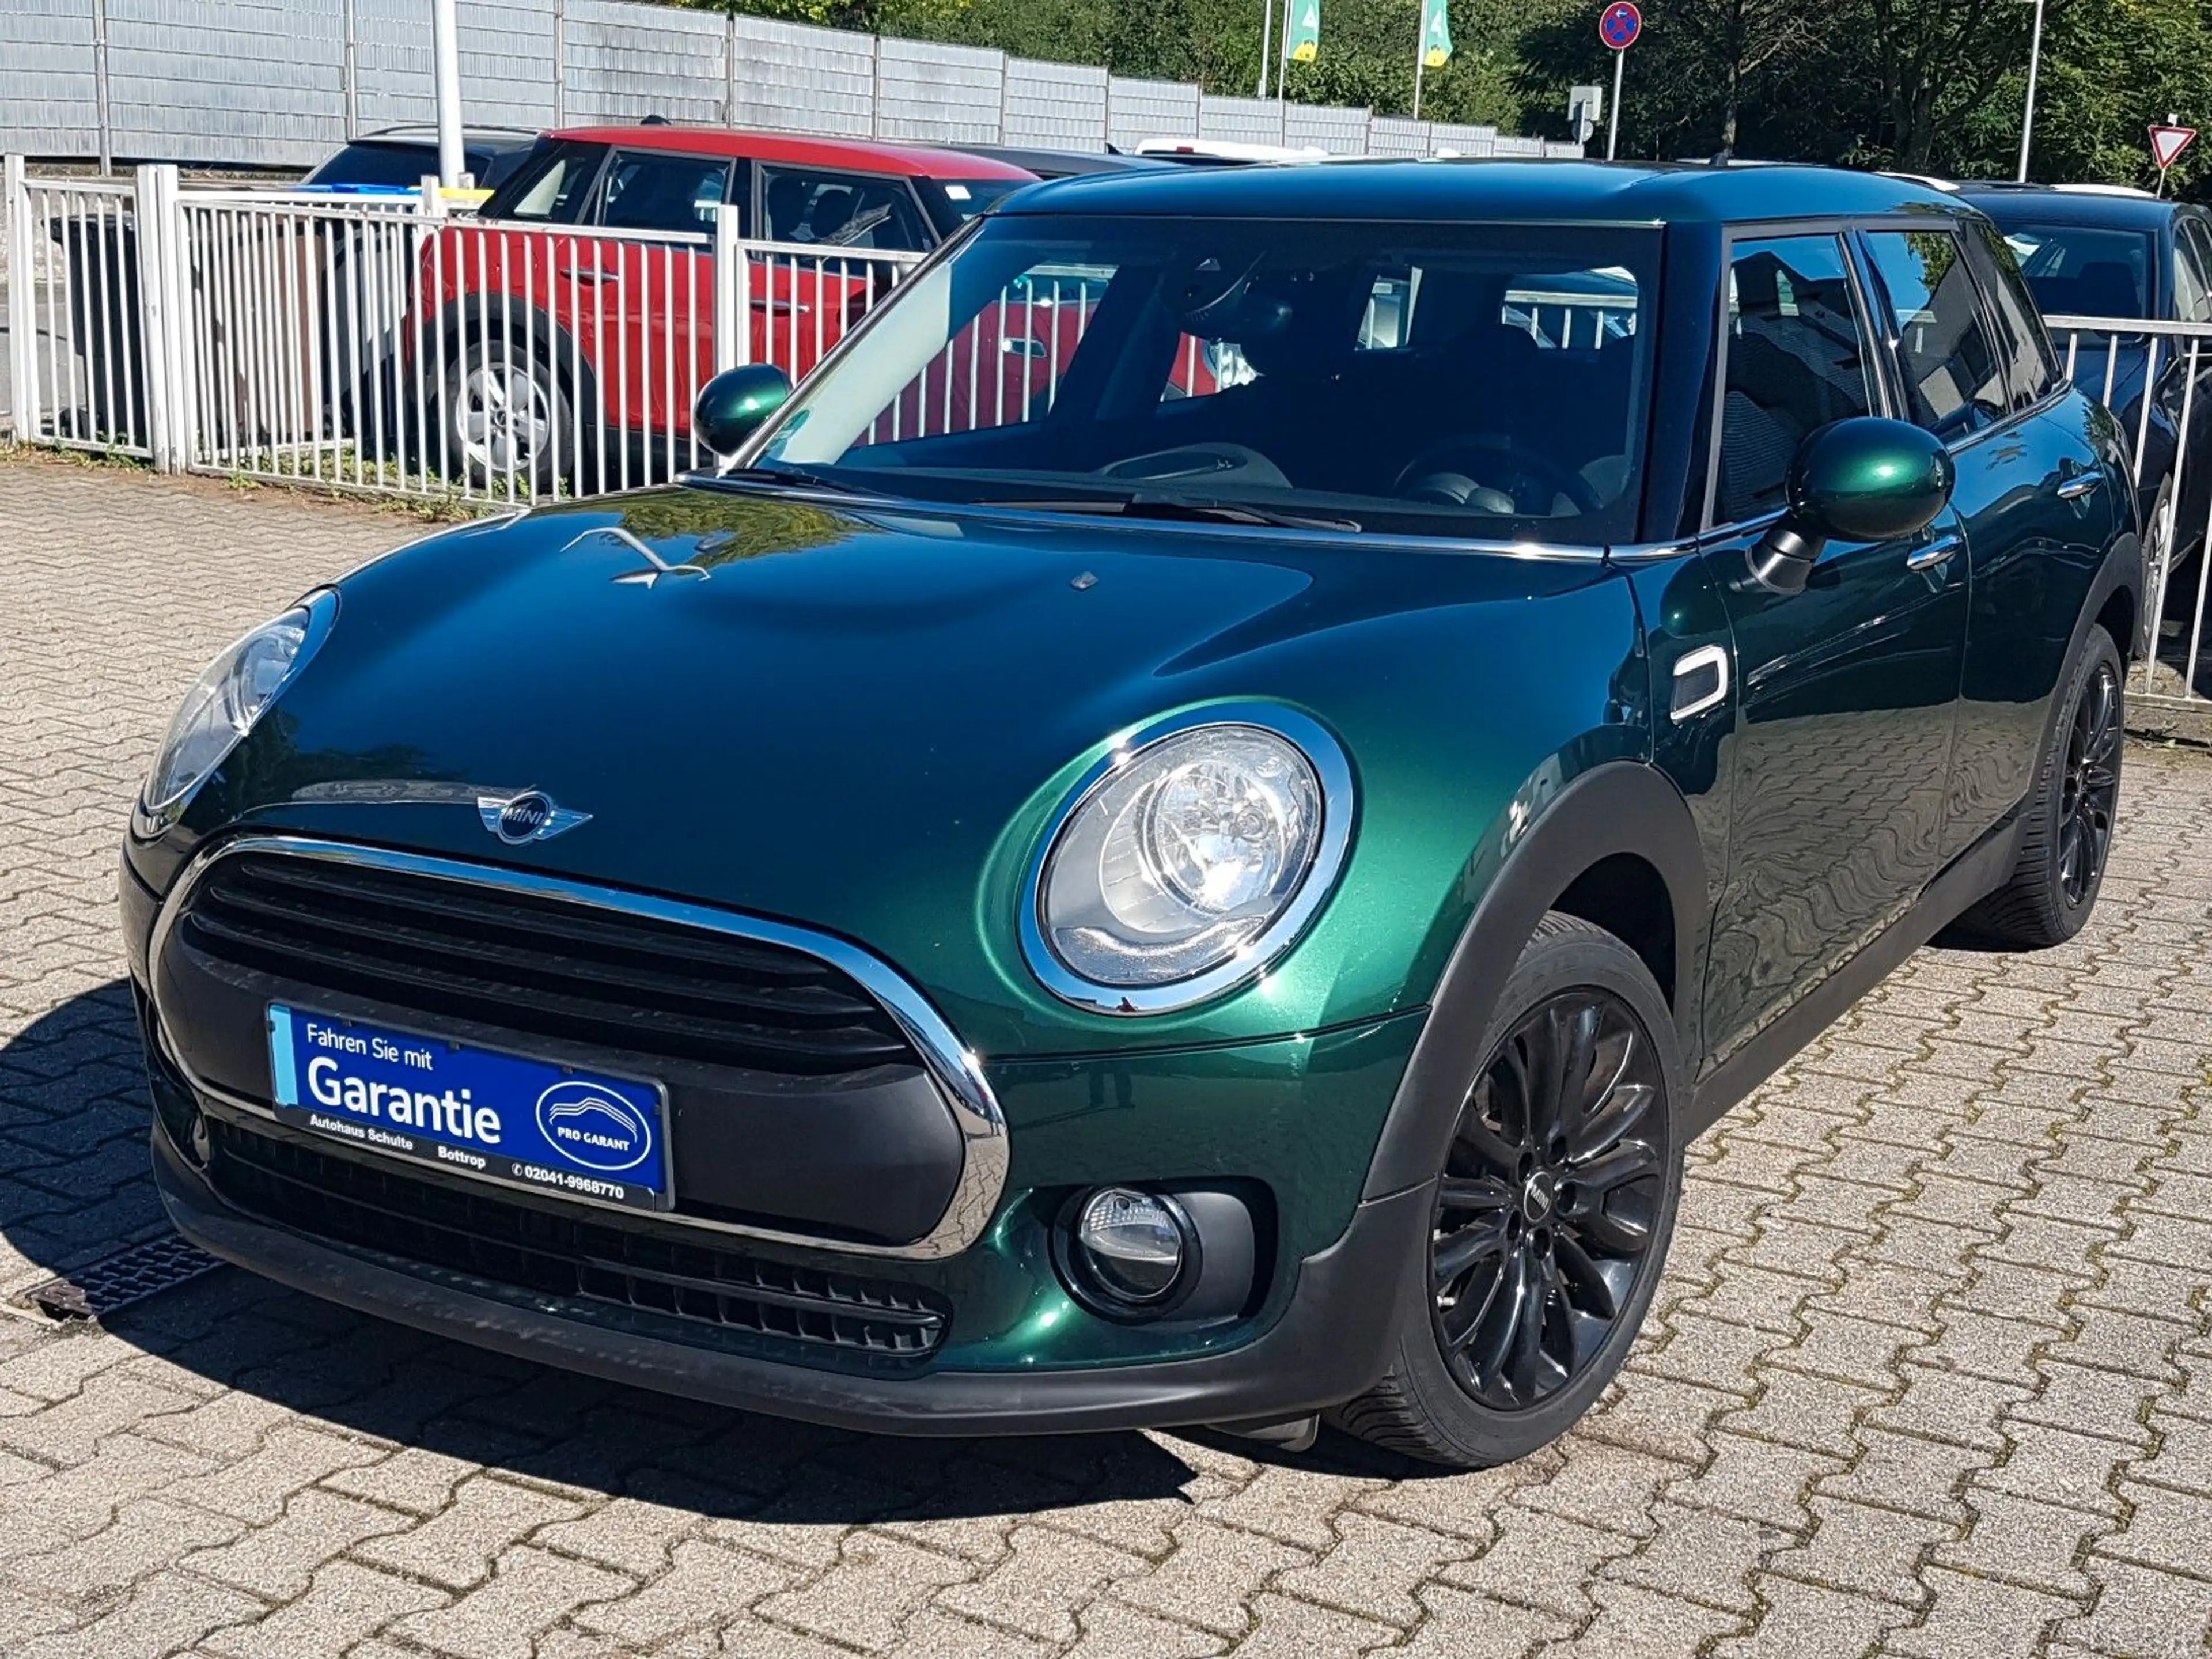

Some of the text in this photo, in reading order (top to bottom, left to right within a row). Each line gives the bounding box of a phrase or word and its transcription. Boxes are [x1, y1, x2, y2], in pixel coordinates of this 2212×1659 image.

[502, 806, 543, 825] MINI
[306, 1022, 433, 1071] Fahren Sie mit
[308, 1056, 501, 1145] Garantie
[309, 1113, 625, 1200] Autohaus Schulte Bottrop 02041-9968770
[557, 1126, 630, 1152] PRO GARANT
